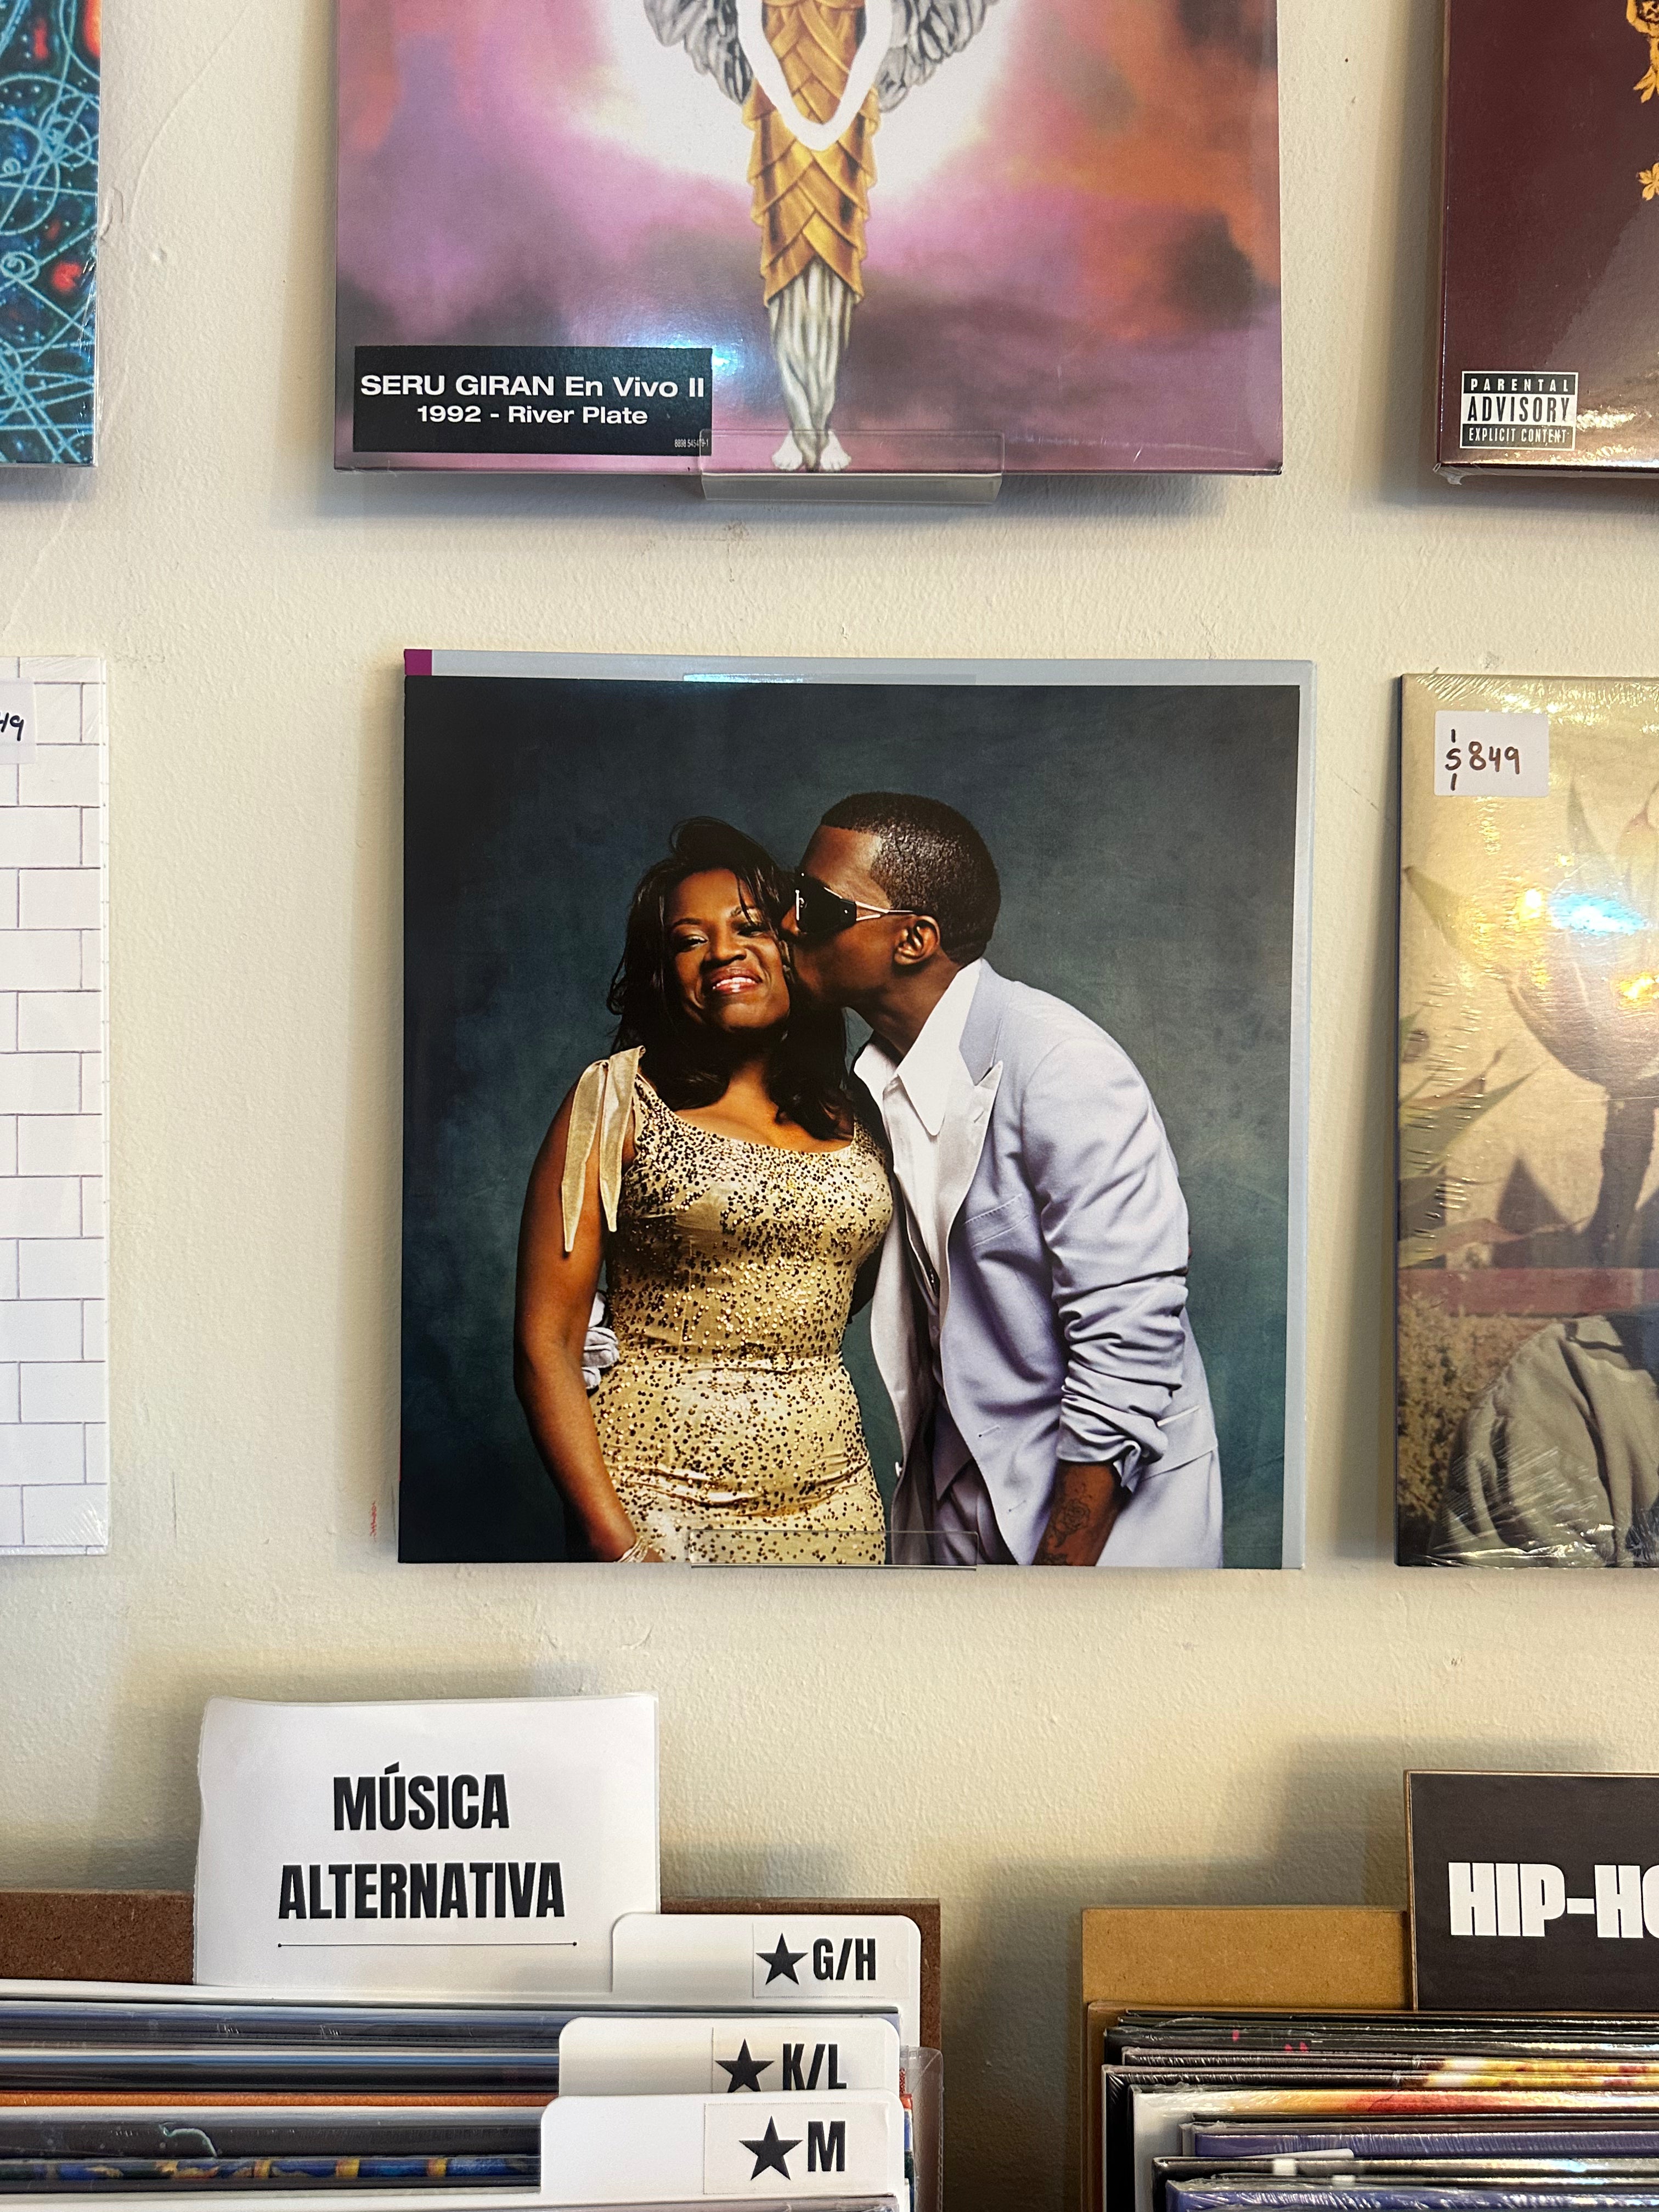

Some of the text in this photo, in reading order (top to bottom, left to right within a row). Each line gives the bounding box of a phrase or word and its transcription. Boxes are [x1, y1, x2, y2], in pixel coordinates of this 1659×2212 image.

[360, 375, 704, 398] SERU GIRAN En Vivo II
[1471, 378, 1568, 392] PARENTAL
[417, 405, 481, 423] 1992
[509, 405, 574, 424] River
[583, 406, 648, 425] Plate
[1468, 396, 1570, 422] ADVISORY
[1469, 428, 1567, 443] EXPLICIT CONTENT
[333, 1762, 510, 1831] MÚSICA
[278, 1862, 565, 1920] ALTERNATIVA
[812, 1938, 876, 1980] G/H
[782, 2043, 847, 2090] K/L
[807, 2120, 845, 2172] M
